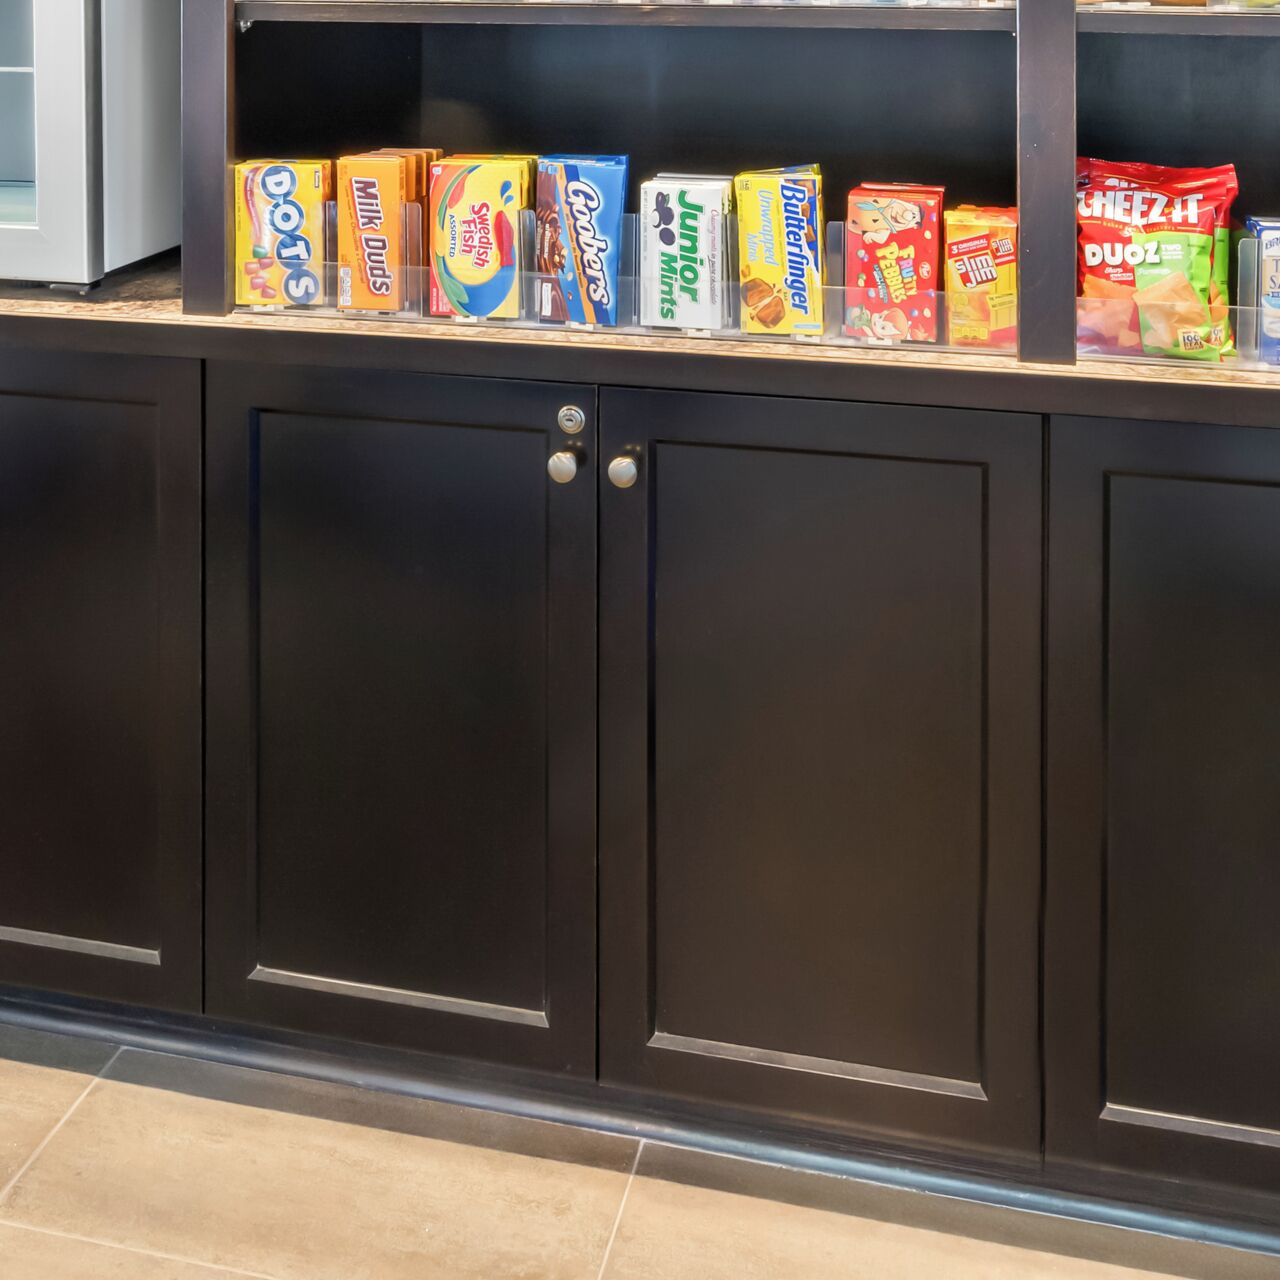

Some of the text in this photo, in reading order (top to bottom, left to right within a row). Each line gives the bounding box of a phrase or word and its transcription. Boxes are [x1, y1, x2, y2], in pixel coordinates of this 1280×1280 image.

[265, 166, 315, 299] DOTS
[353, 179, 391, 294] Milk Duds
[461, 217, 477, 255] Fish
[471, 202, 494, 269] Swedish
[758, 190, 778, 266] Unwrapped
[1077, 191, 1204, 226] CHEEZ-IT
[566, 181, 609, 306] Goobers
[678, 190, 705, 303] Junior
[780, 185, 808, 315] Butterfinger
[875, 242, 906, 304] PEBBLES
[951, 245, 958, 254] 3
[1085, 241, 1161, 267] DUOZ
[660, 252, 680, 320] Mints
